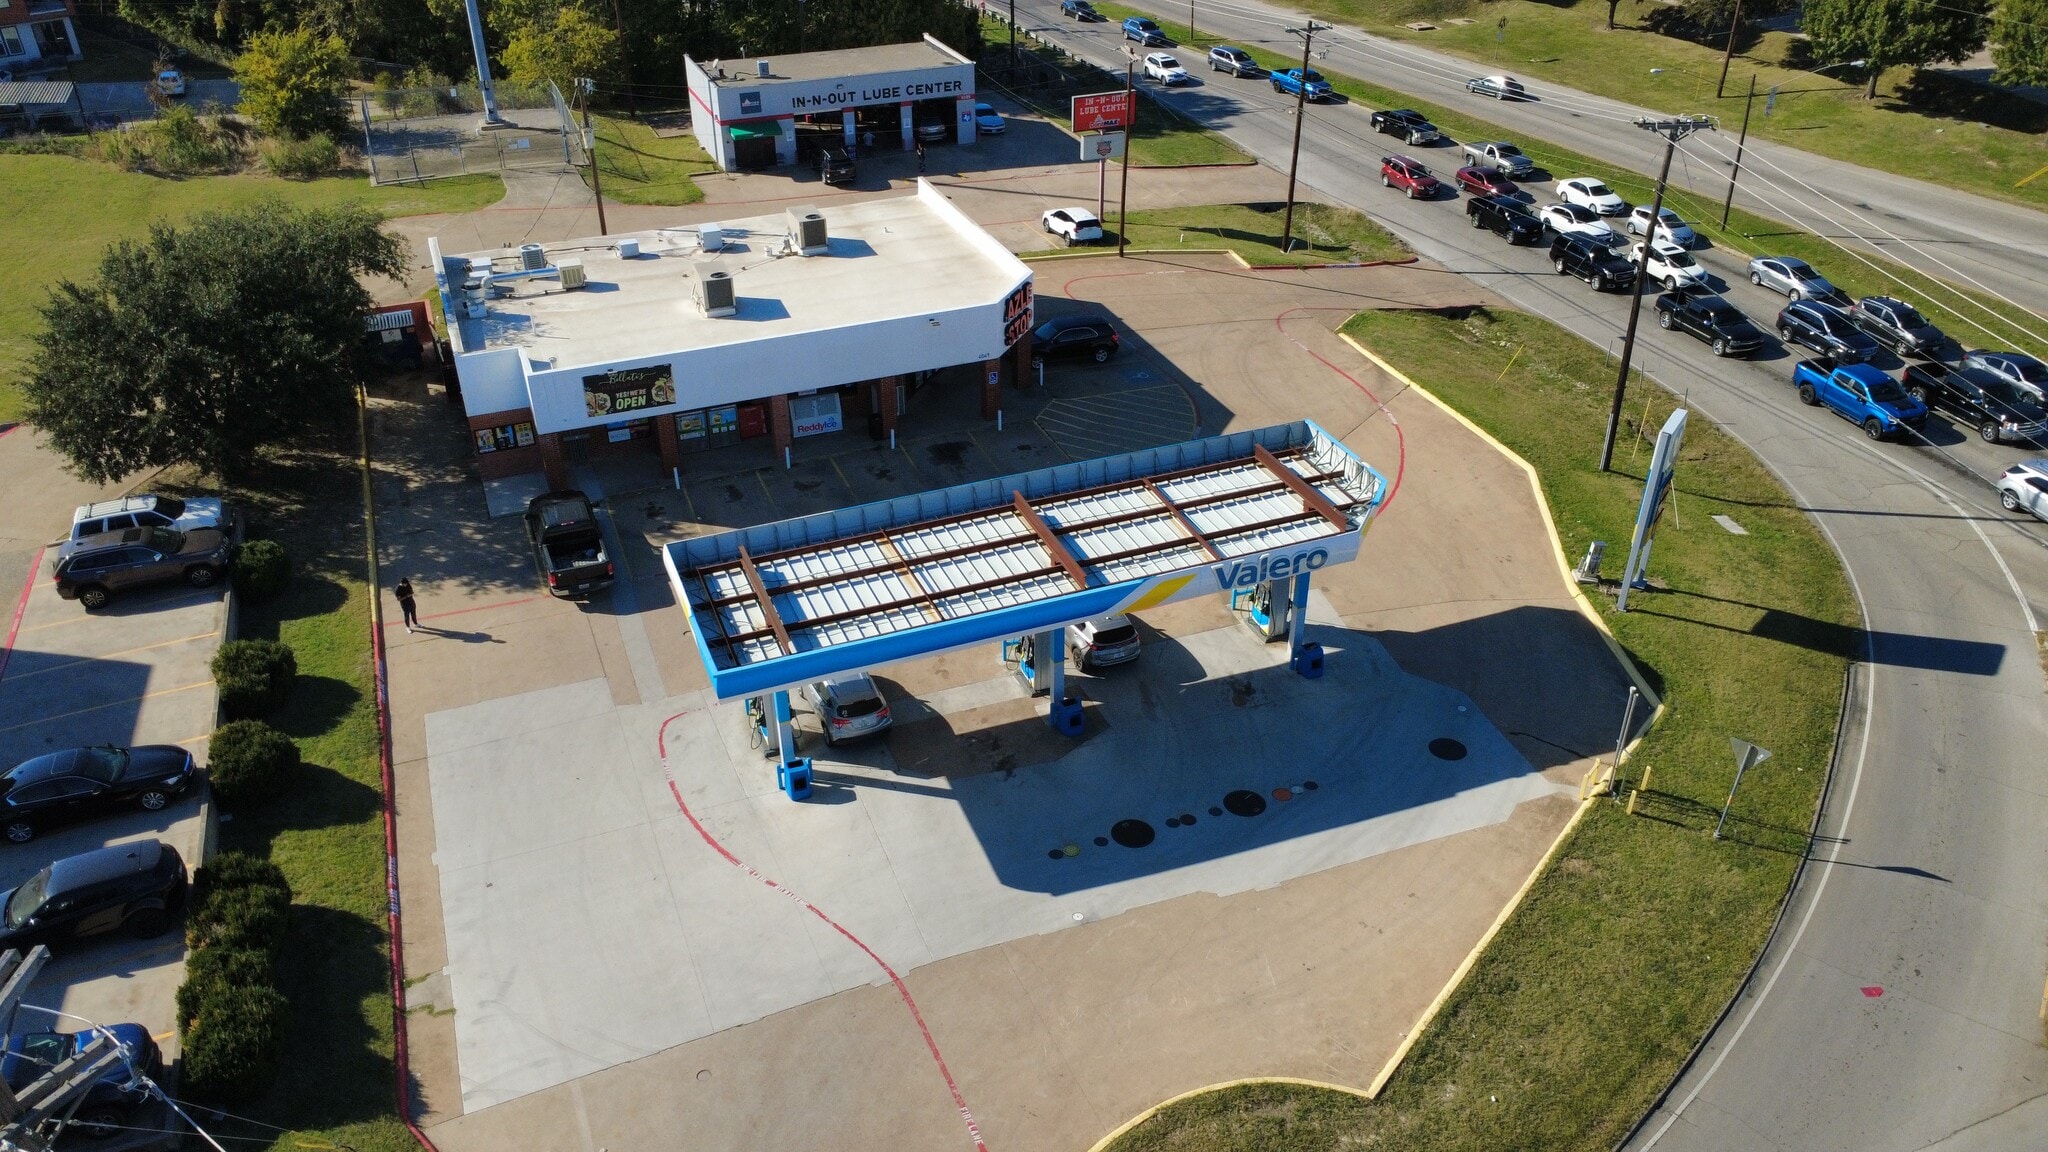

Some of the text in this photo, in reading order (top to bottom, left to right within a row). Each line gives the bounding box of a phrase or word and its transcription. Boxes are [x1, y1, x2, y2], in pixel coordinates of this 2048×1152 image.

[792, 80, 962, 108] IN-N-OUT LUBE CENTER
[1080, 103, 1126, 115] LUBE CENTE
[1004, 282, 1032, 322] AZLE
[1004, 308, 1032, 346] STOP
[616, 395, 646, 410] OPEN
[1211, 547, 1329, 590] Valero
[960, 1107, 983, 1145] FIRE LANE
